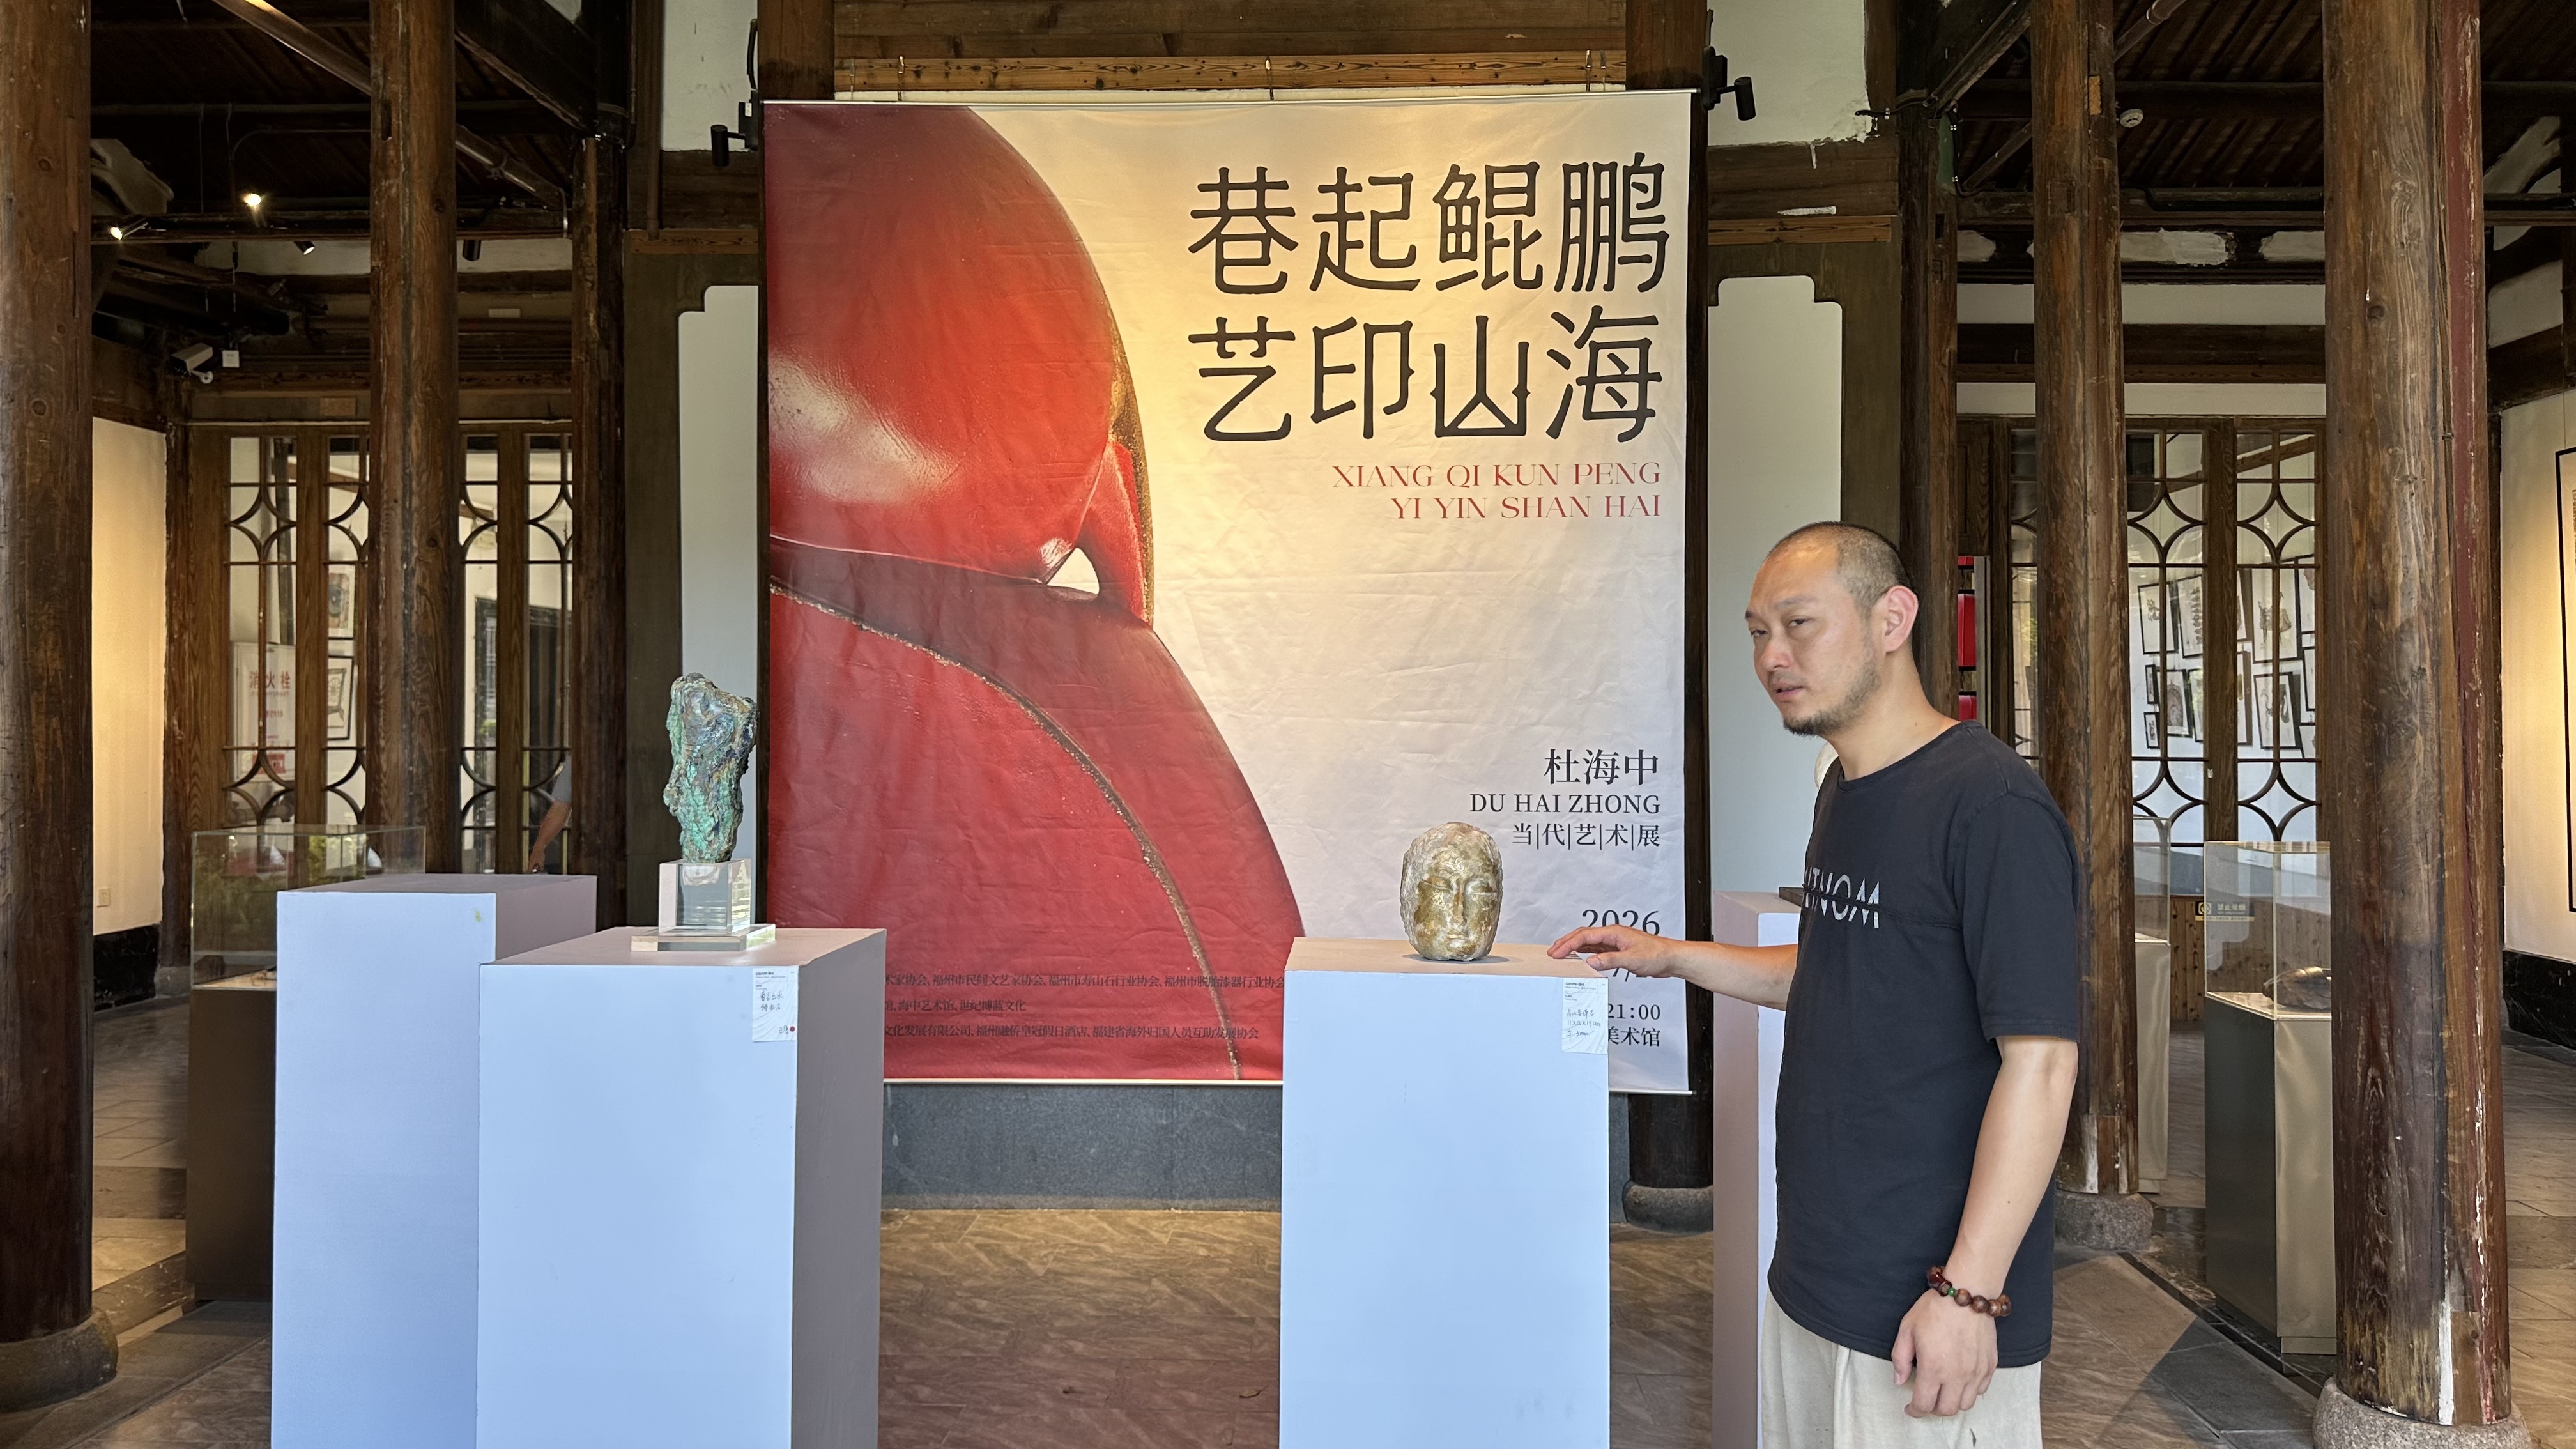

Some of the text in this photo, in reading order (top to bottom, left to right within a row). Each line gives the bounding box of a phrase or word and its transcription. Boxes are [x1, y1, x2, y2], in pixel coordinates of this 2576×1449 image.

[1188, 152, 1669, 295] 巷起鲲鹏
[1188, 305, 1663, 442] 艺印山海
[1333, 463, 1661, 488] XIANG QI KUN PENG
[1392, 495, 1660, 519] YI YIN SHAN HAI
[1544, 748, 1659, 786] 杜海中
[1469, 793, 1661, 815] DU HAI ZHONG
[1582, 909, 1660, 936] 2026
